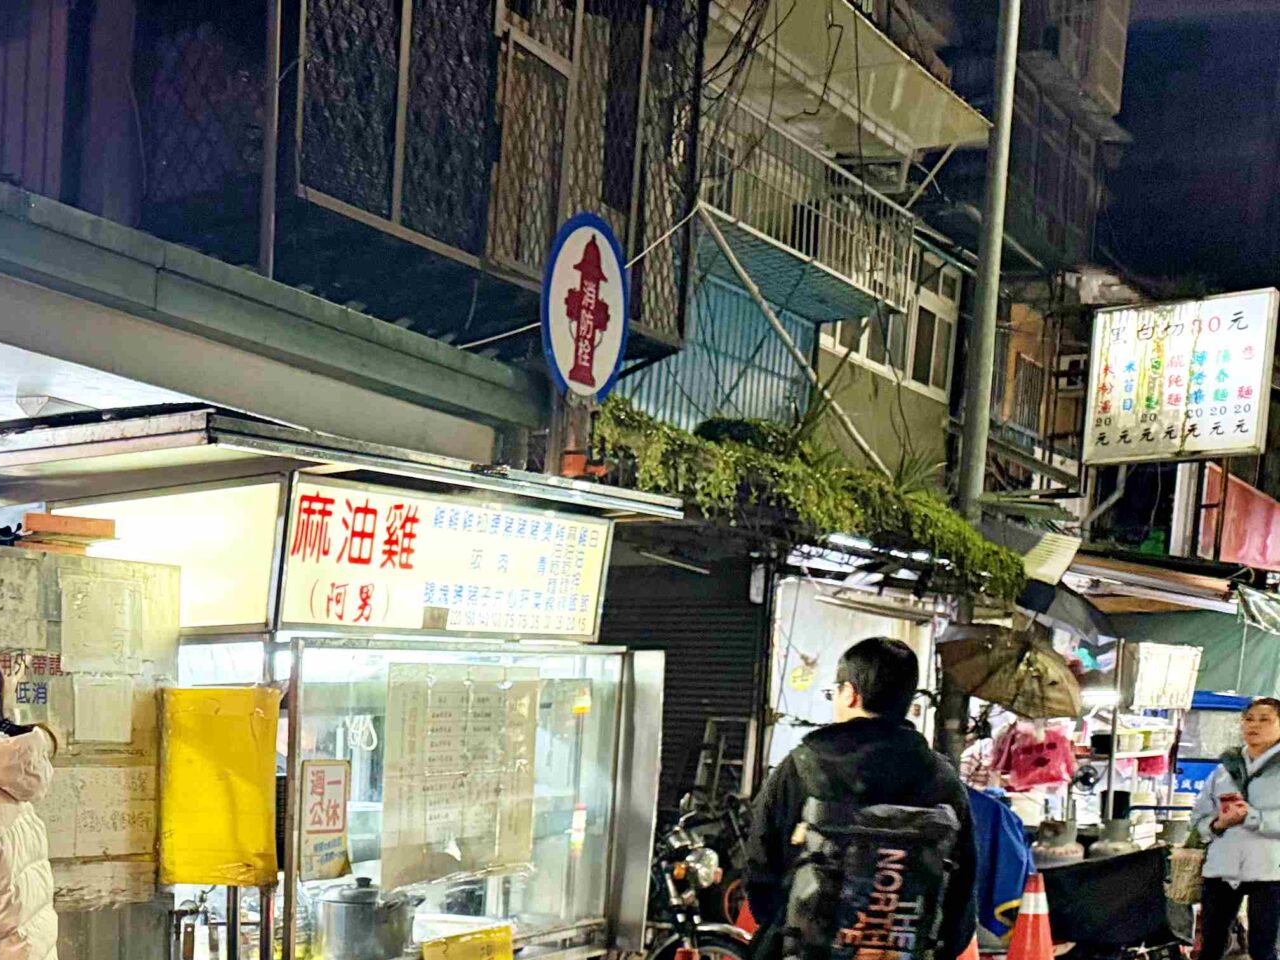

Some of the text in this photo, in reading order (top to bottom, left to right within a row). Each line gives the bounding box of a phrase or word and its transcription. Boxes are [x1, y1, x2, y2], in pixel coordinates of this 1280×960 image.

[290, 491, 420, 570] 麻油雞
[14, 681, 48, 705] 低消
[310, 770, 342, 796] 週一
[309, 799, 340, 827] 公休
[862, 848, 907, 947] NORTH
[890, 894, 924, 950] THE
